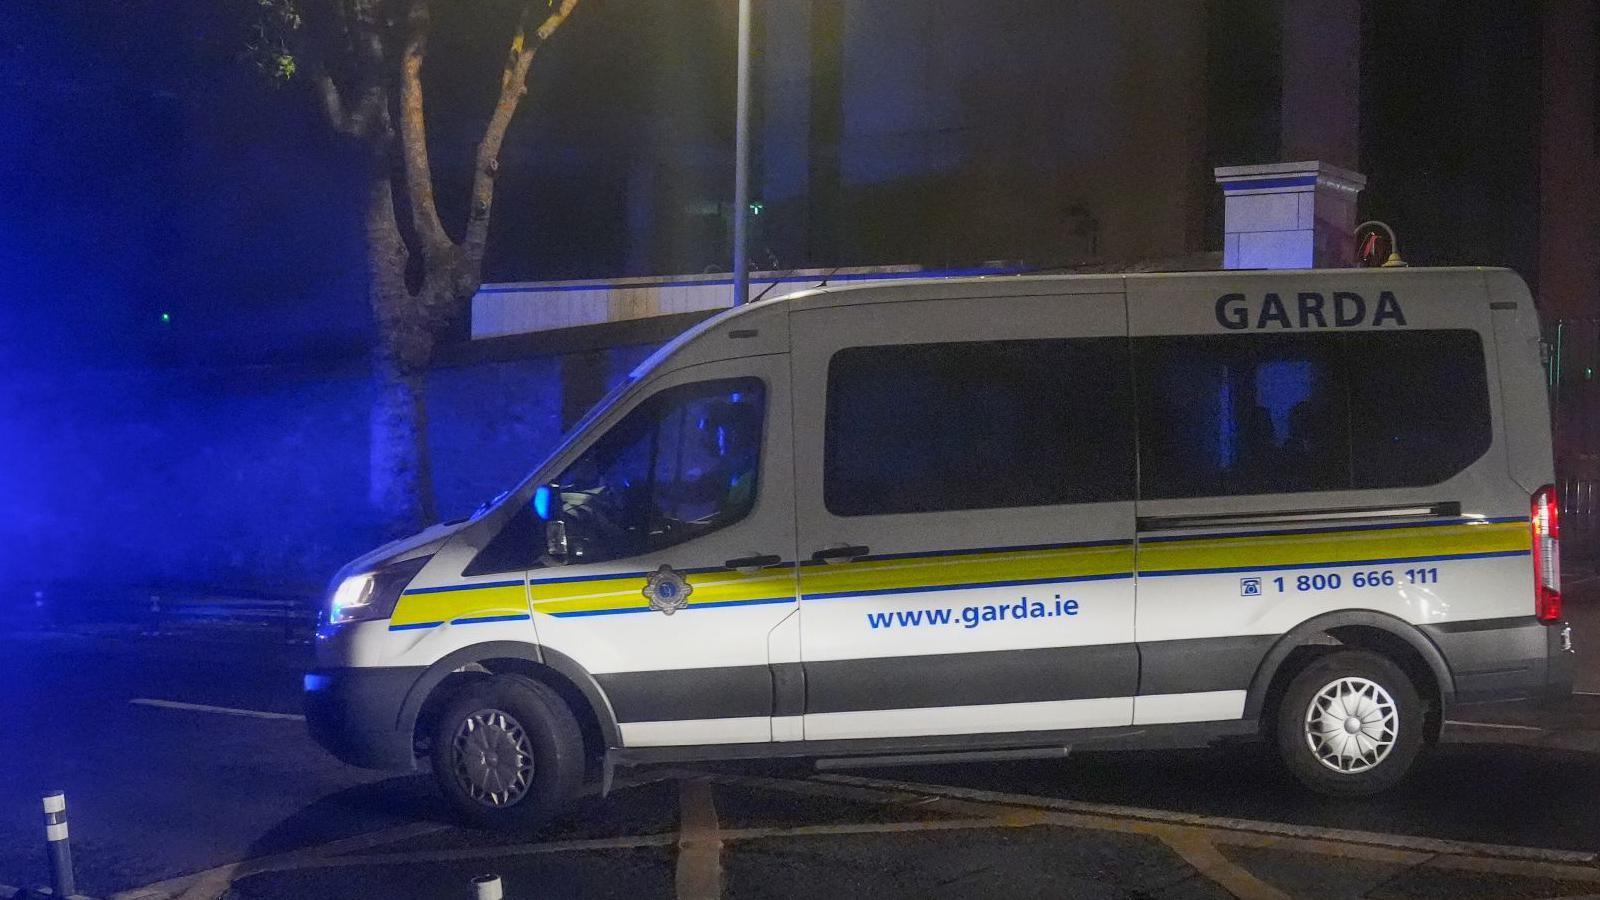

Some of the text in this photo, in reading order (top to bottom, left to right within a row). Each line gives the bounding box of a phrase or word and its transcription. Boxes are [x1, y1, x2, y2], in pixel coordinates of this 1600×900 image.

[1215, 291, 1407, 330] GARDA
[1273, 568, 1438, 592] 1 800 666 111
[867, 594, 1079, 629] www.garda.ie
